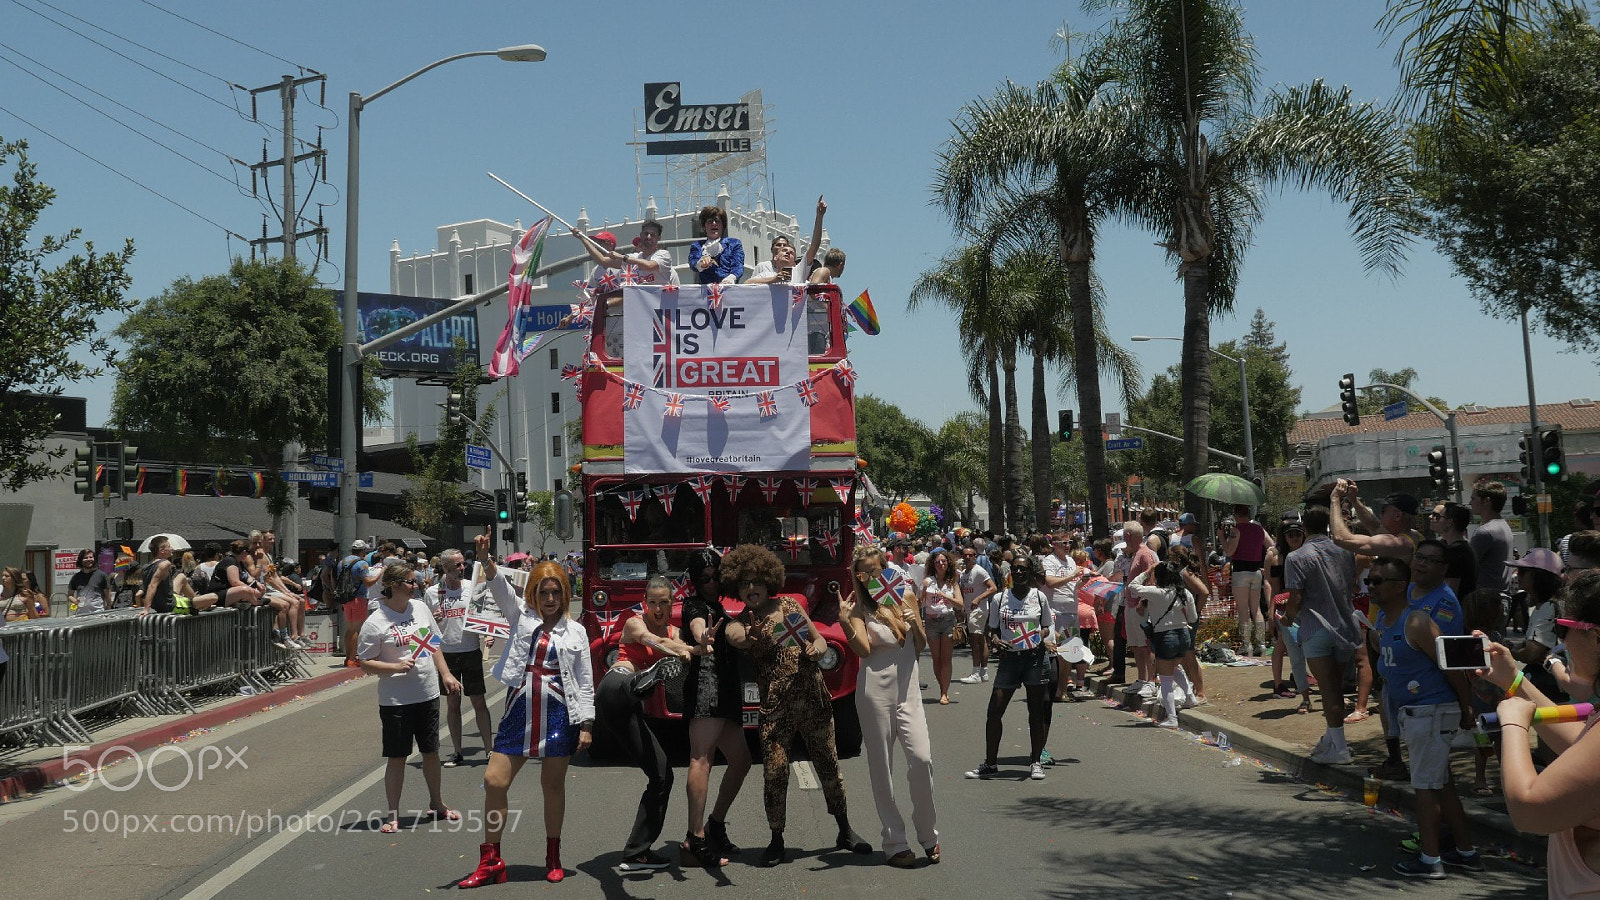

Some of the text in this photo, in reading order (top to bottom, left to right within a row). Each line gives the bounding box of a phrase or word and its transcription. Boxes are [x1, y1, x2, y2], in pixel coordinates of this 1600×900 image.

[647, 83, 749, 132] Emser
[715, 139, 749, 152] TILE
[675, 307, 746, 331] LOVE
[675, 333, 700, 355] IS
[679, 360, 776, 385] GREAT
[288, 472, 327, 481] HOLLOWAY
